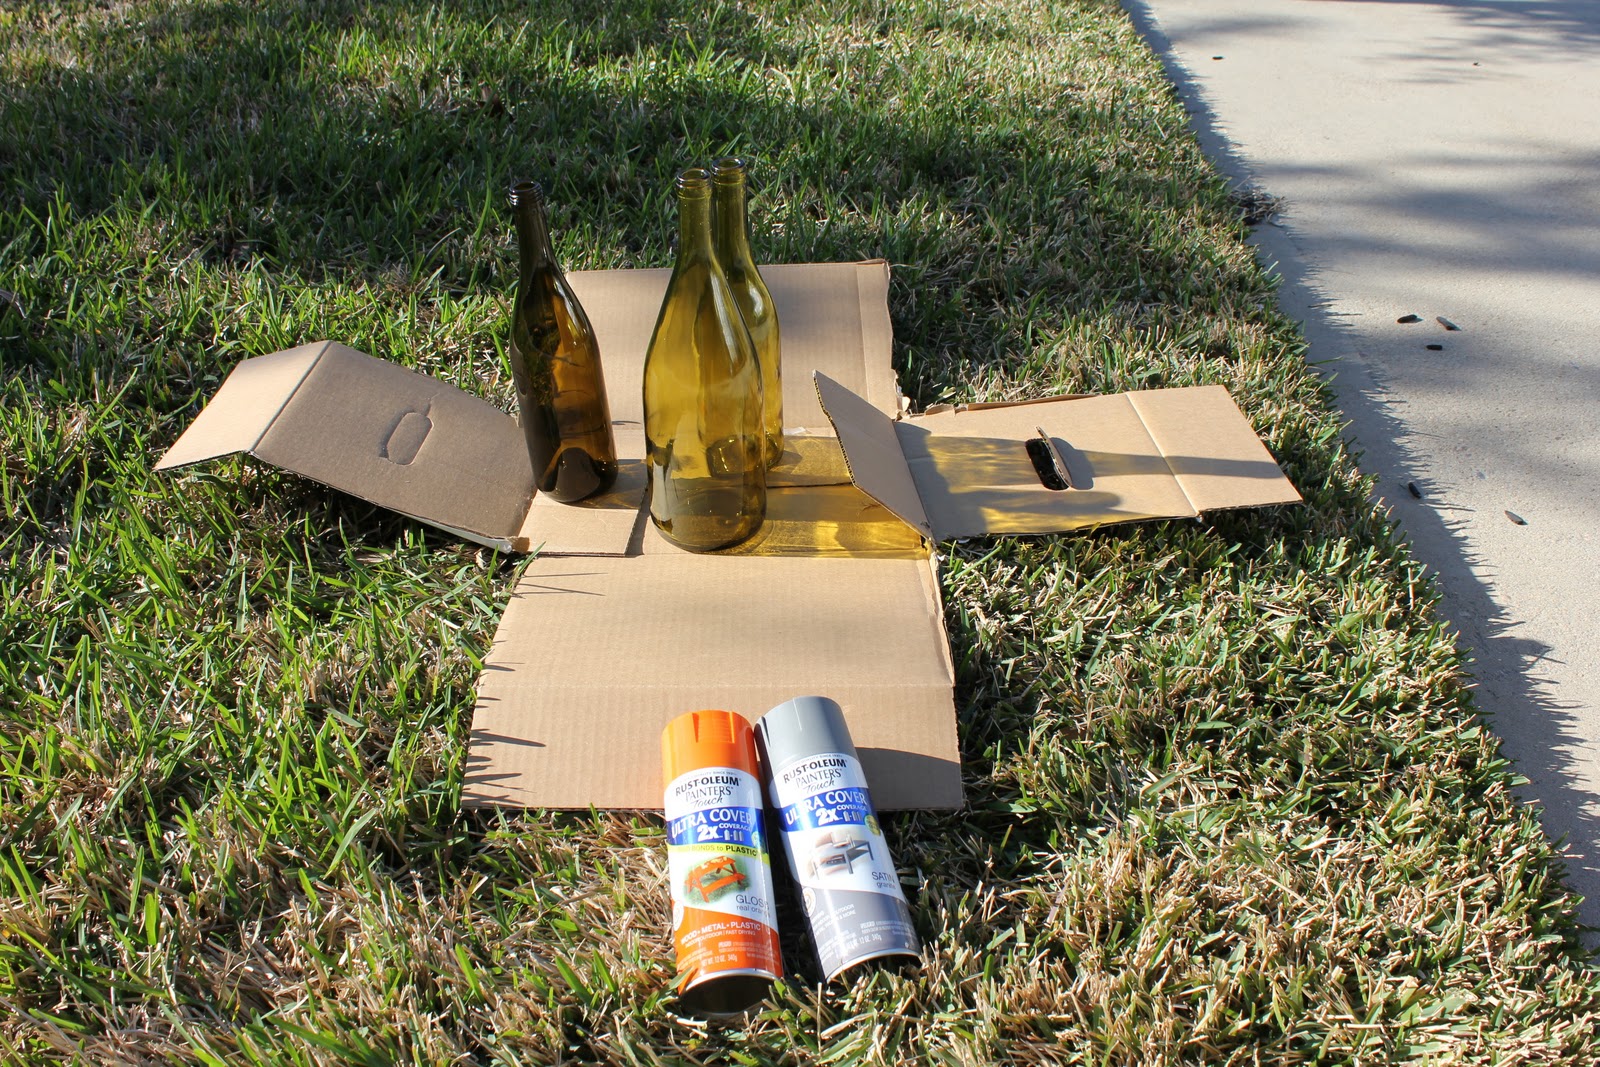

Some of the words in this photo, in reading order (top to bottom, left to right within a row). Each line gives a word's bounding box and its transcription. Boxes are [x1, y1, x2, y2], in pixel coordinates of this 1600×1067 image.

[785, 796, 824, 825] ULRA
[825, 790, 868, 805] COVER
[671, 812, 708, 839] ULTRA
[709, 808, 753, 825] COVER
[725, 845, 758, 857] PLASTIC
[871, 871, 895, 883] SATIN
[701, 922, 727, 934] METAL
[730, 921, 761, 931] PLASTIC
